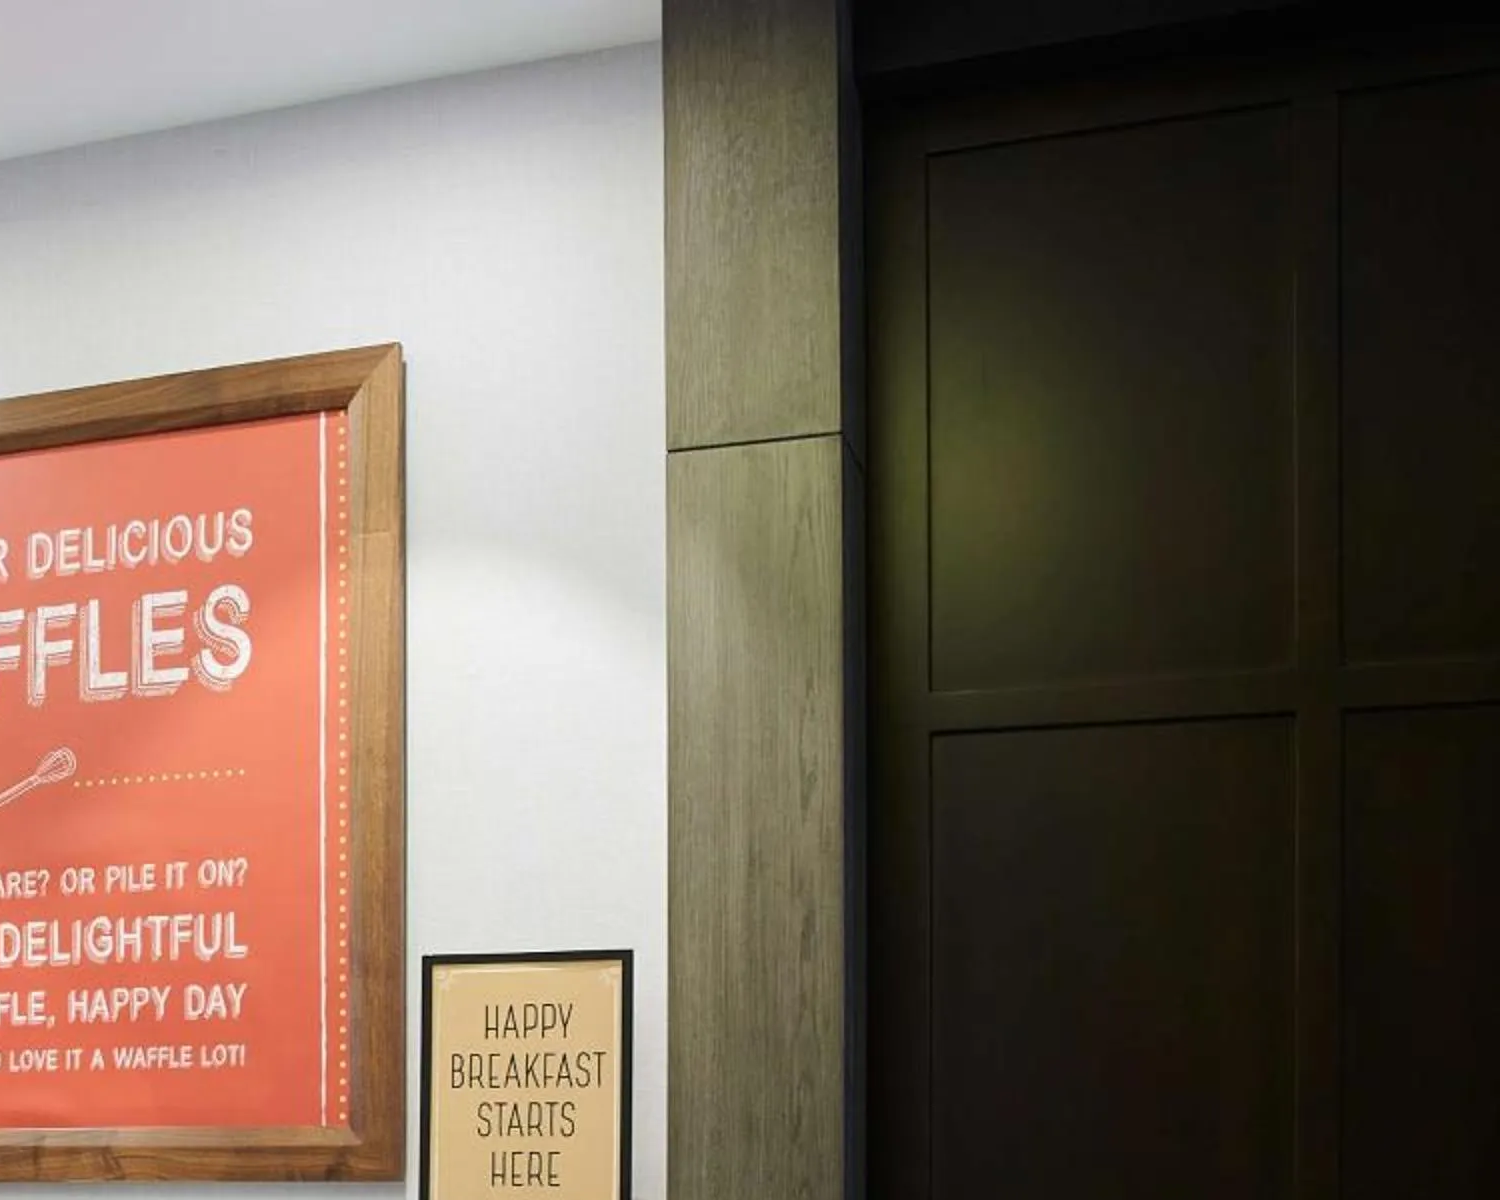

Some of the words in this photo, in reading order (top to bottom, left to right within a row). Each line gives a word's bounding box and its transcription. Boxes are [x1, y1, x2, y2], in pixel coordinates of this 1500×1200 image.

[26, 507, 254, 580] DELICIOUS
[60, 867, 96, 896] OR
[105, 863, 157, 894] PILE
[165, 861, 189, 890] IT
[198, 857, 248, 888] ON?
[68, 984, 171, 1024] HAPPY
[184, 983, 247, 1021] DAY
[484, 1003, 573, 1040] HAPPY
[9, 1049, 58, 1073] LOVE
[65, 1048, 82, 1071] IT
[90, 1047, 105, 1071] A
[112, 1045, 193, 1070] WAFFLE
[201, 1043, 246, 1068] LOT!
[451, 1051, 607, 1089] BREAKFAST
[477, 1101, 576, 1137] STARTS
[491, 1151, 561, 1187] HERE
